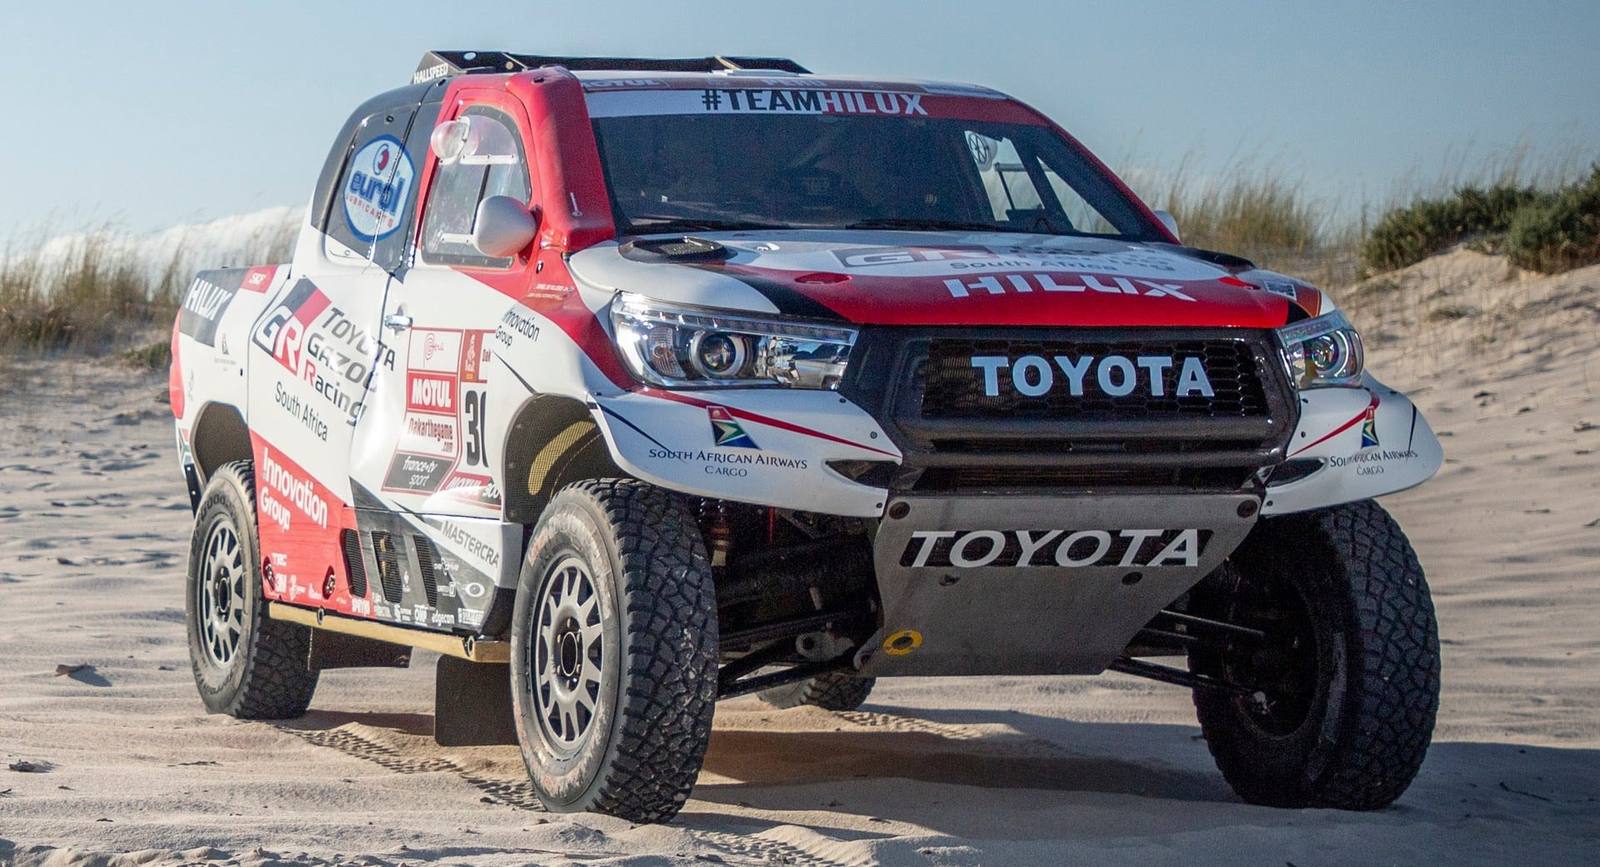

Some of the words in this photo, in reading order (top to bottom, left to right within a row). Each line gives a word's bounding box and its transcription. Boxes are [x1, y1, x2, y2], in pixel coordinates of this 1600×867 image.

[701, 89, 929, 116] #TEAMHILUX
[950, 259, 1031, 271] South
[184, 277, 233, 321] HILUX
[942, 273, 1198, 303] HILUX
[255, 304, 305, 375] GR
[303, 358, 368, 428] Racing
[411, 378, 453, 409] MOTUL
[970, 355, 1216, 398] TOYOTA
[274, 380, 301, 419] South
[301, 403, 329, 442] Africa
[648, 449, 693, 460] SOUTH
[696, 450, 752, 464] AFRICAN
[754, 454, 809, 470] AIRWAYS
[704, 465, 748, 478] CARGO
[1356, 465, 1385, 476] CARGO
[262, 446, 328, 530] Innovation
[260, 485, 292, 533] Group
[441, 520, 500, 569] MASTERCRA
[912, 528, 1200, 568] TOYOTA
